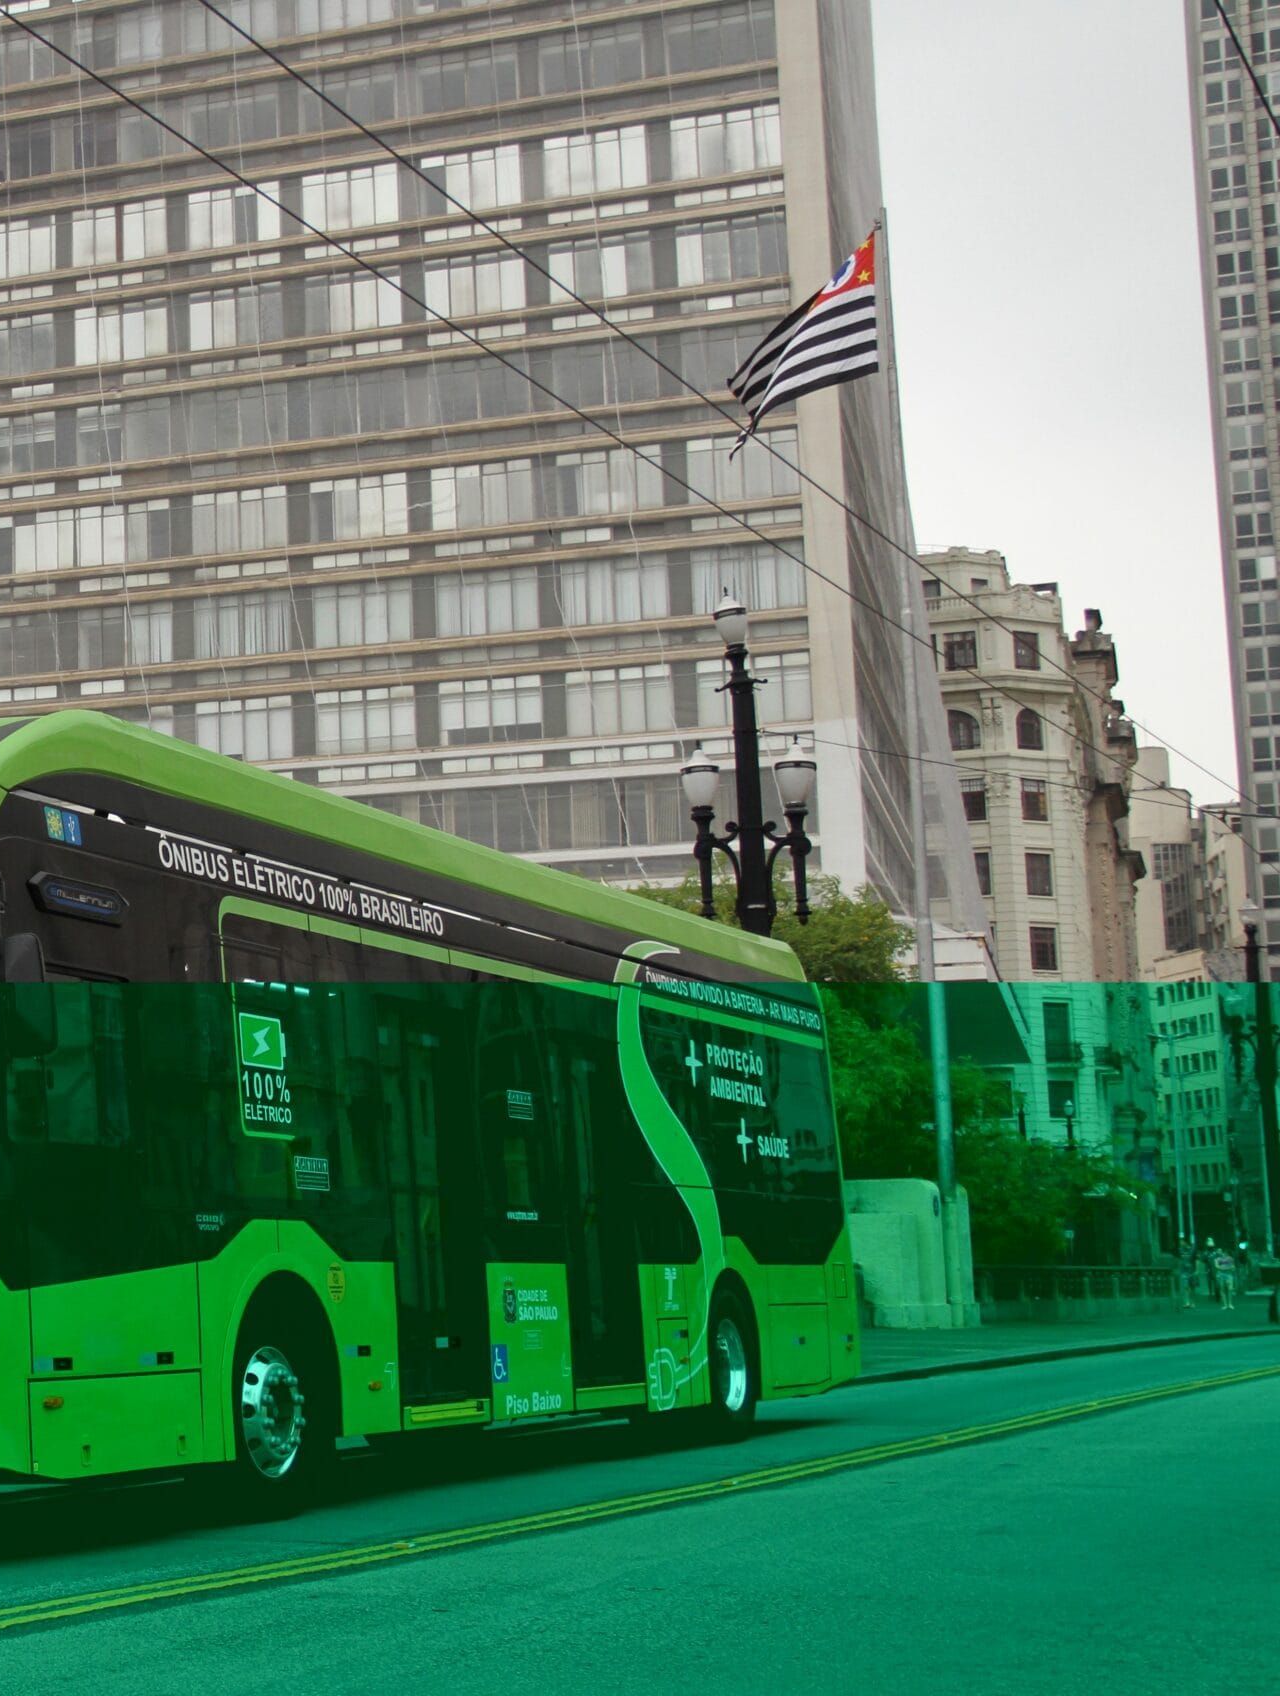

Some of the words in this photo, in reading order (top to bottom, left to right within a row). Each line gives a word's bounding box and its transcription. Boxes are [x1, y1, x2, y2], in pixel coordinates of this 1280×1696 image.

[158, 831, 229, 882] ÔNIBUS
[232, 857, 315, 905] ELÉTRICO
[319, 882, 358, 917] 100%
[360, 893, 444, 937] BRASILEIRO
[690, 982, 722, 1006] MOVIDO
[724, 989, 732, 1007] A
[732, 990, 765, 1016] BATERIA
[770, 1000, 780, 1020] AR
[781, 1003, 799, 1024] MAIS
[799, 1009, 821, 1030] PURO
[706, 1043, 764, 1079] PROTEÇÃO
[242, 1070, 291, 1103] 100%
[710, 1076, 767, 1107] AMBIENTAL
[244, 1100, 292, 1124] ELÉTRICO
[757, 1132, 790, 1159] SAÚDE
[517, 1290, 539, 1302] CIDADE
[539, 1290, 548, 1302] DE
[518, 1304, 534, 1321] SÃO
[534, 1306, 558, 1320] PAULO
[506, 1394, 529, 1416] Piso
[531, 1390, 562, 1412] Baixo
